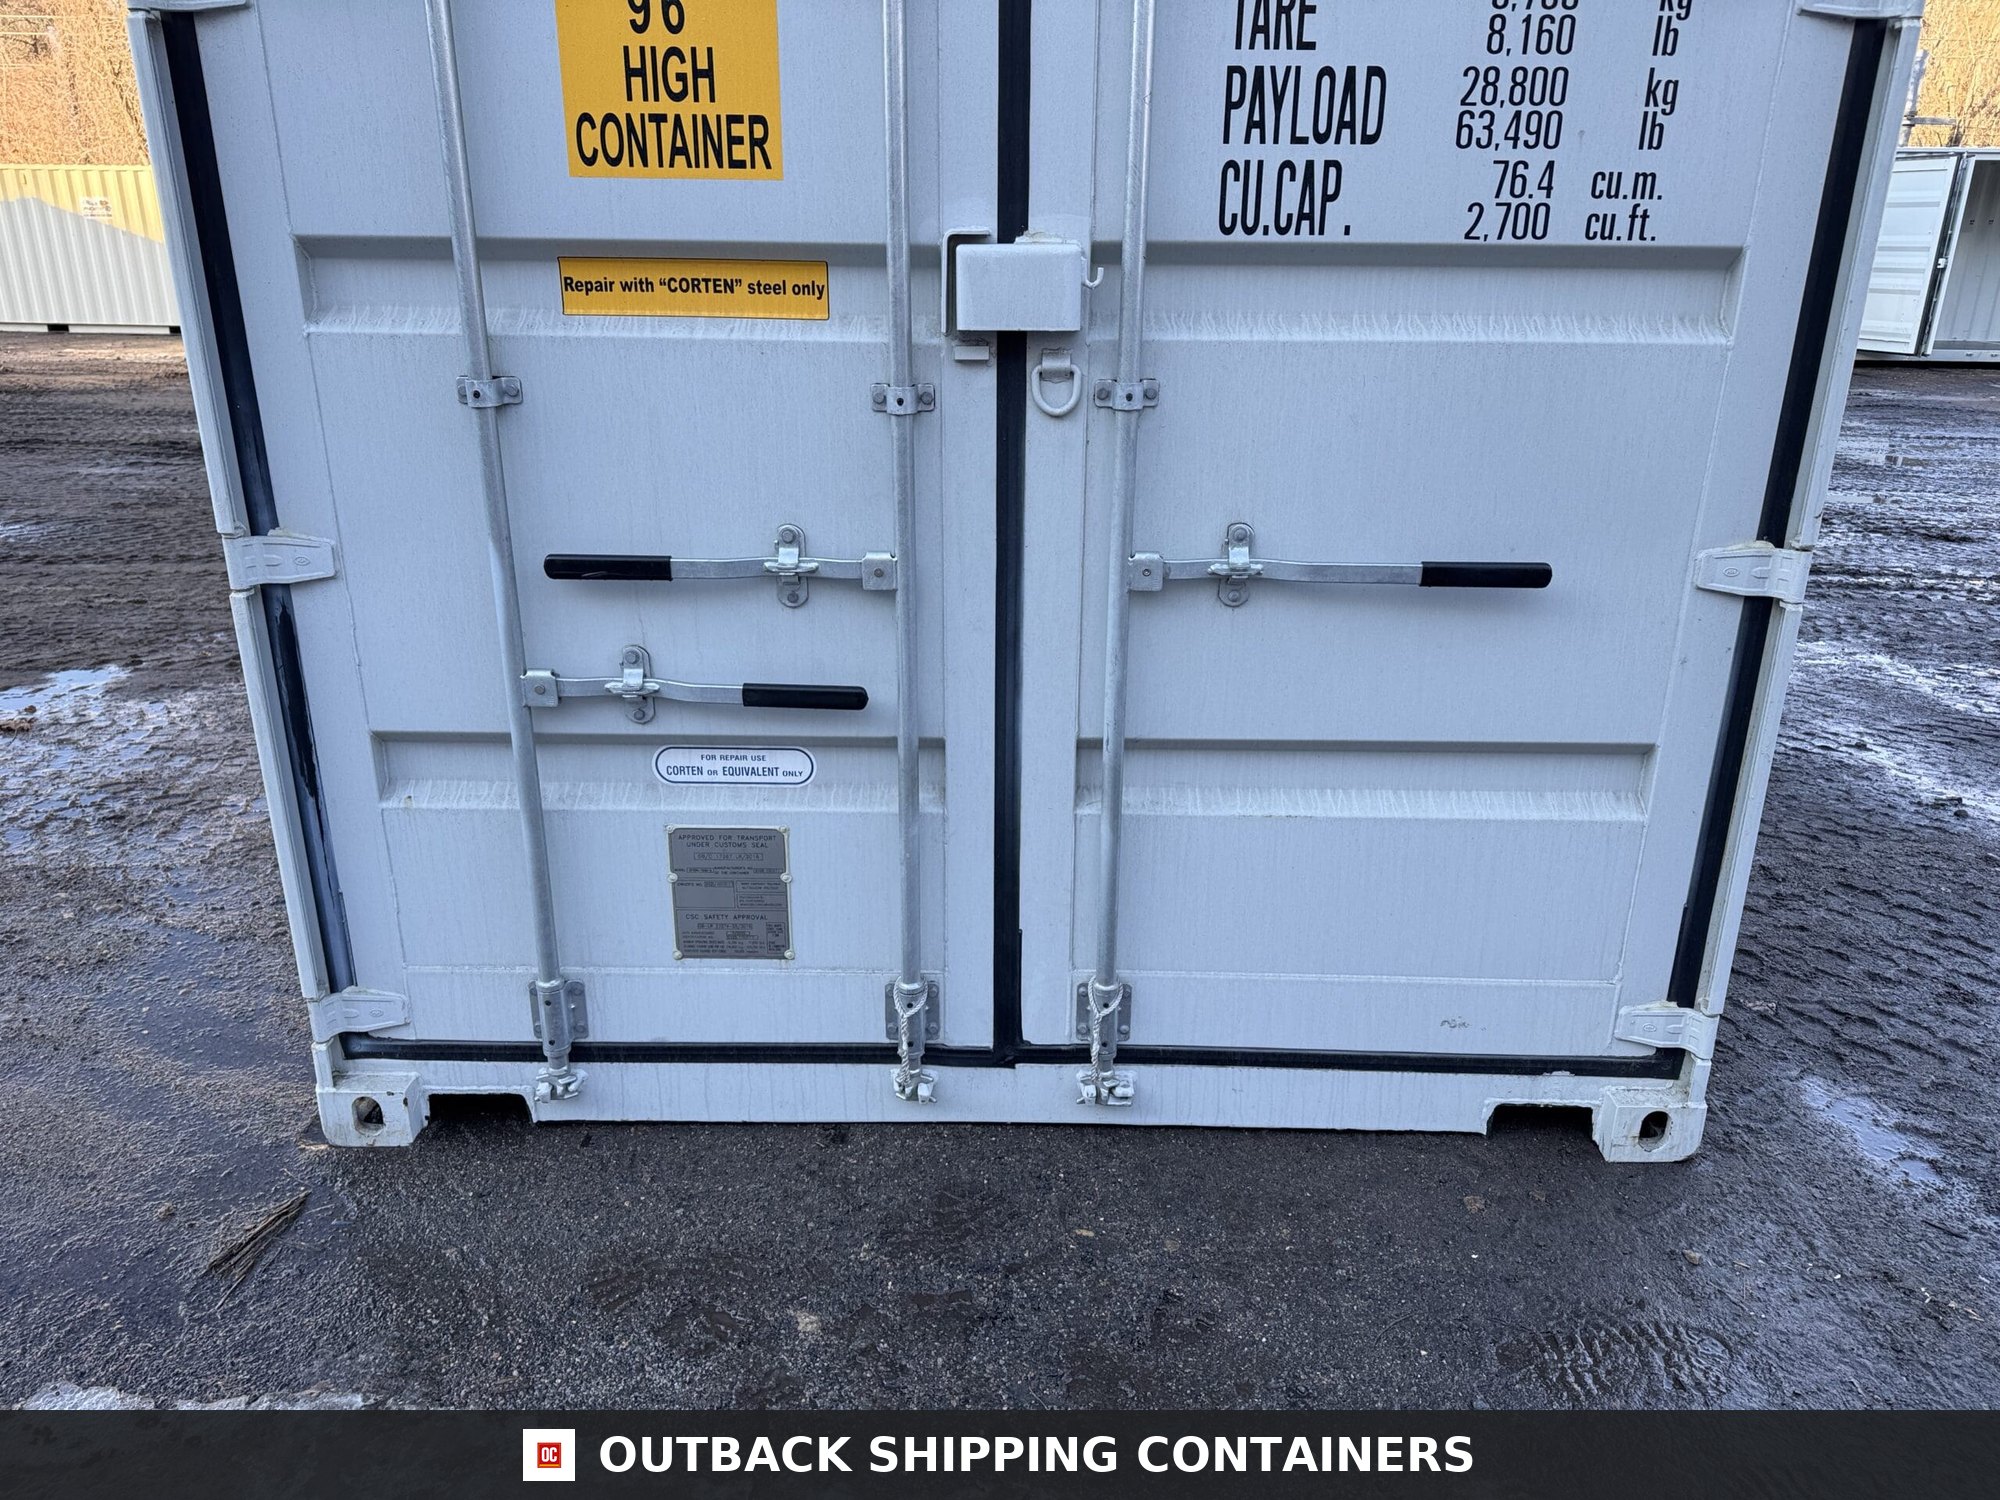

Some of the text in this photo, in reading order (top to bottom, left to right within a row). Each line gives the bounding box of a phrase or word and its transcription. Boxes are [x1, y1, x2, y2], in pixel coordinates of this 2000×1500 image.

[1235, 0, 1316, 50] TARE
[1487, 14, 1679, 56] 8,160 lb
[623, 46, 716, 103] HIGH
[1222, 66, 1680, 145] PAYLOAD 28,800 kg
[576, 112, 772, 170] CONTAINER
[1456, 110, 1665, 151] 63,490 lb
[1492, 160, 1555, 199] 76.4
[1591, 171, 1663, 200] cu.m.
[1464, 202, 1656, 242] 2,700 cu.ft.
[564, 276, 615, 294] Repair
[620, 277, 655, 293] with
[748, 280, 787, 296] steel
[792, 280, 825, 300] only
[666, 765, 703, 776] CORTEN
[722, 766, 779, 777] EQUIVALENT
